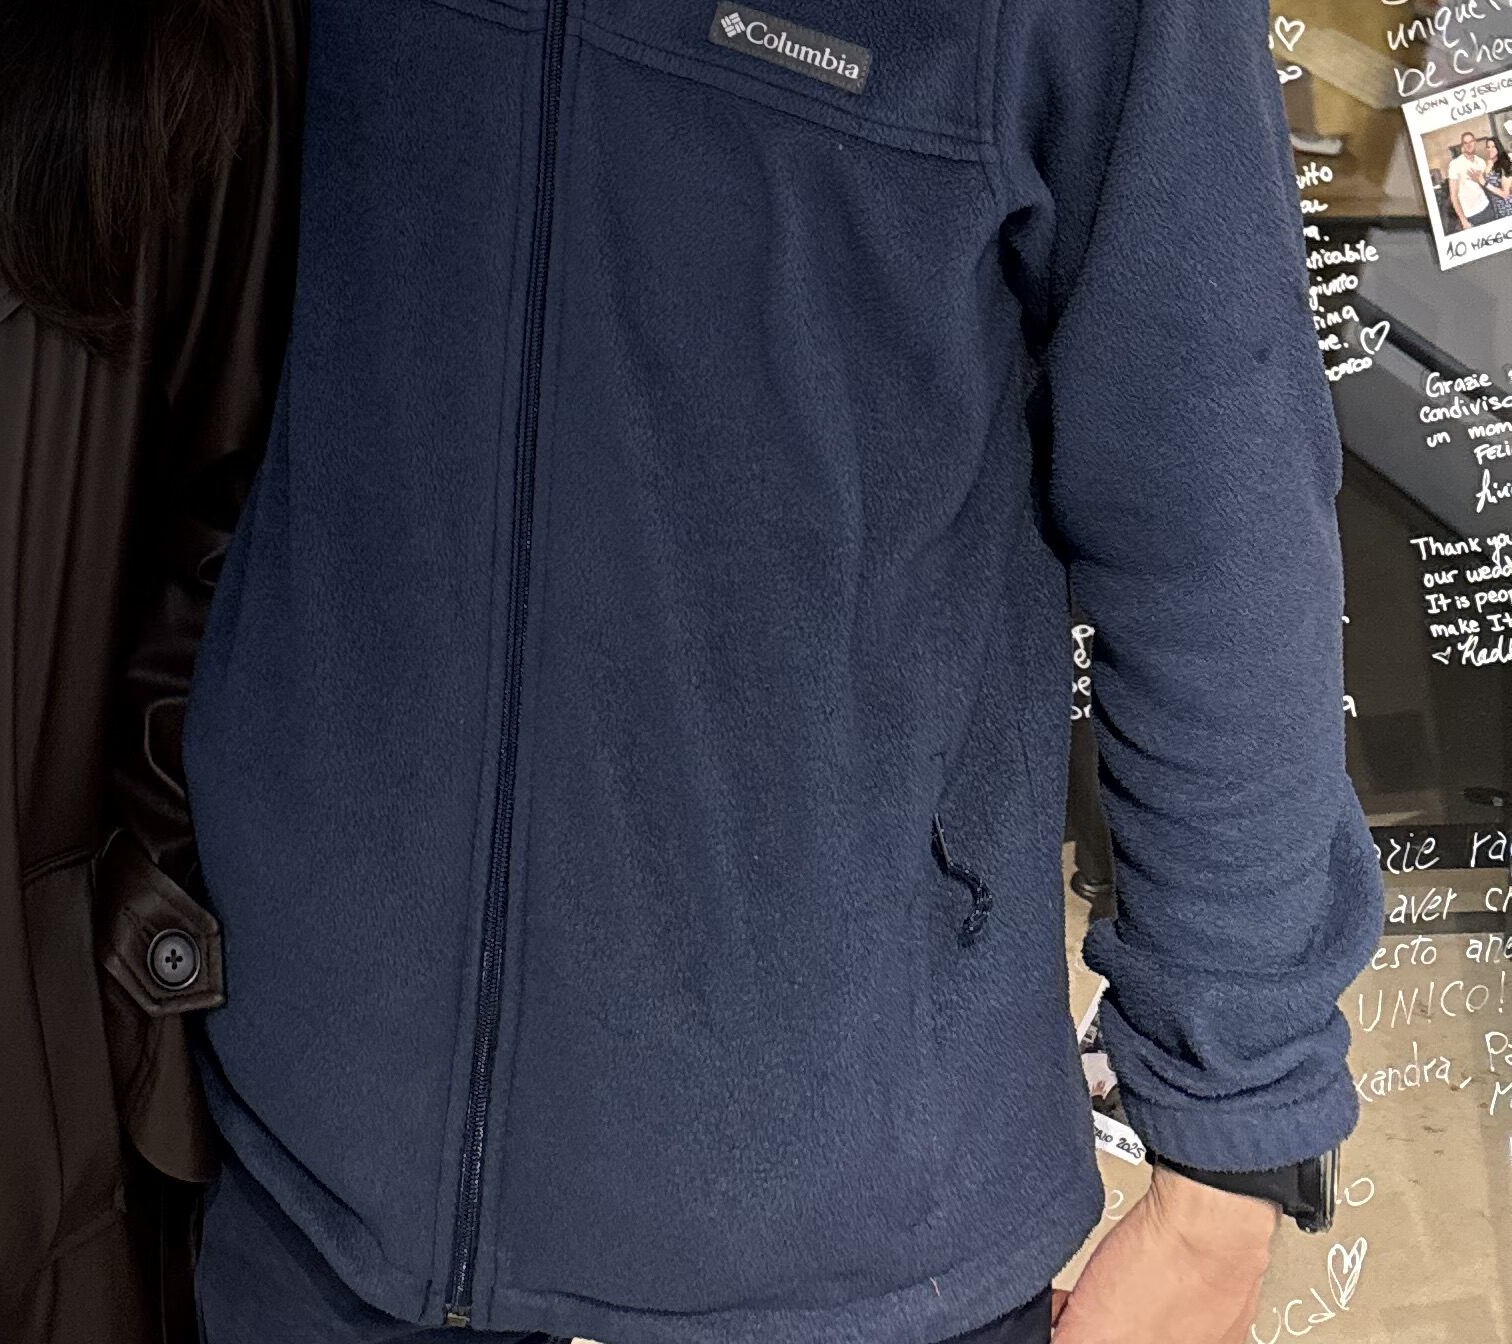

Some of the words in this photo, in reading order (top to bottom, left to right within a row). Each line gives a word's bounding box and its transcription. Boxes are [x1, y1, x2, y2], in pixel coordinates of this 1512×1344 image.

[1387, 0, 1486, 48] unique
[745, 21, 859, 79] Columbia
[1395, 62, 1443, 97] be
[1450, 100, 1488, 120] (USA)
[1447, 241, 1467, 260] 10
[1426, 372, 1492, 398] Grazie
[1427, 432, 1450, 448] un
[1410, 536, 1482, 560] Thank
[1424, 570, 1458, 588] our
[1425, 594, 1452, 613] It
[1430, 618, 1480, 637] make
[1371, 934, 1437, 971] esto
[1116, 1137, 1146, 1159] 2025
